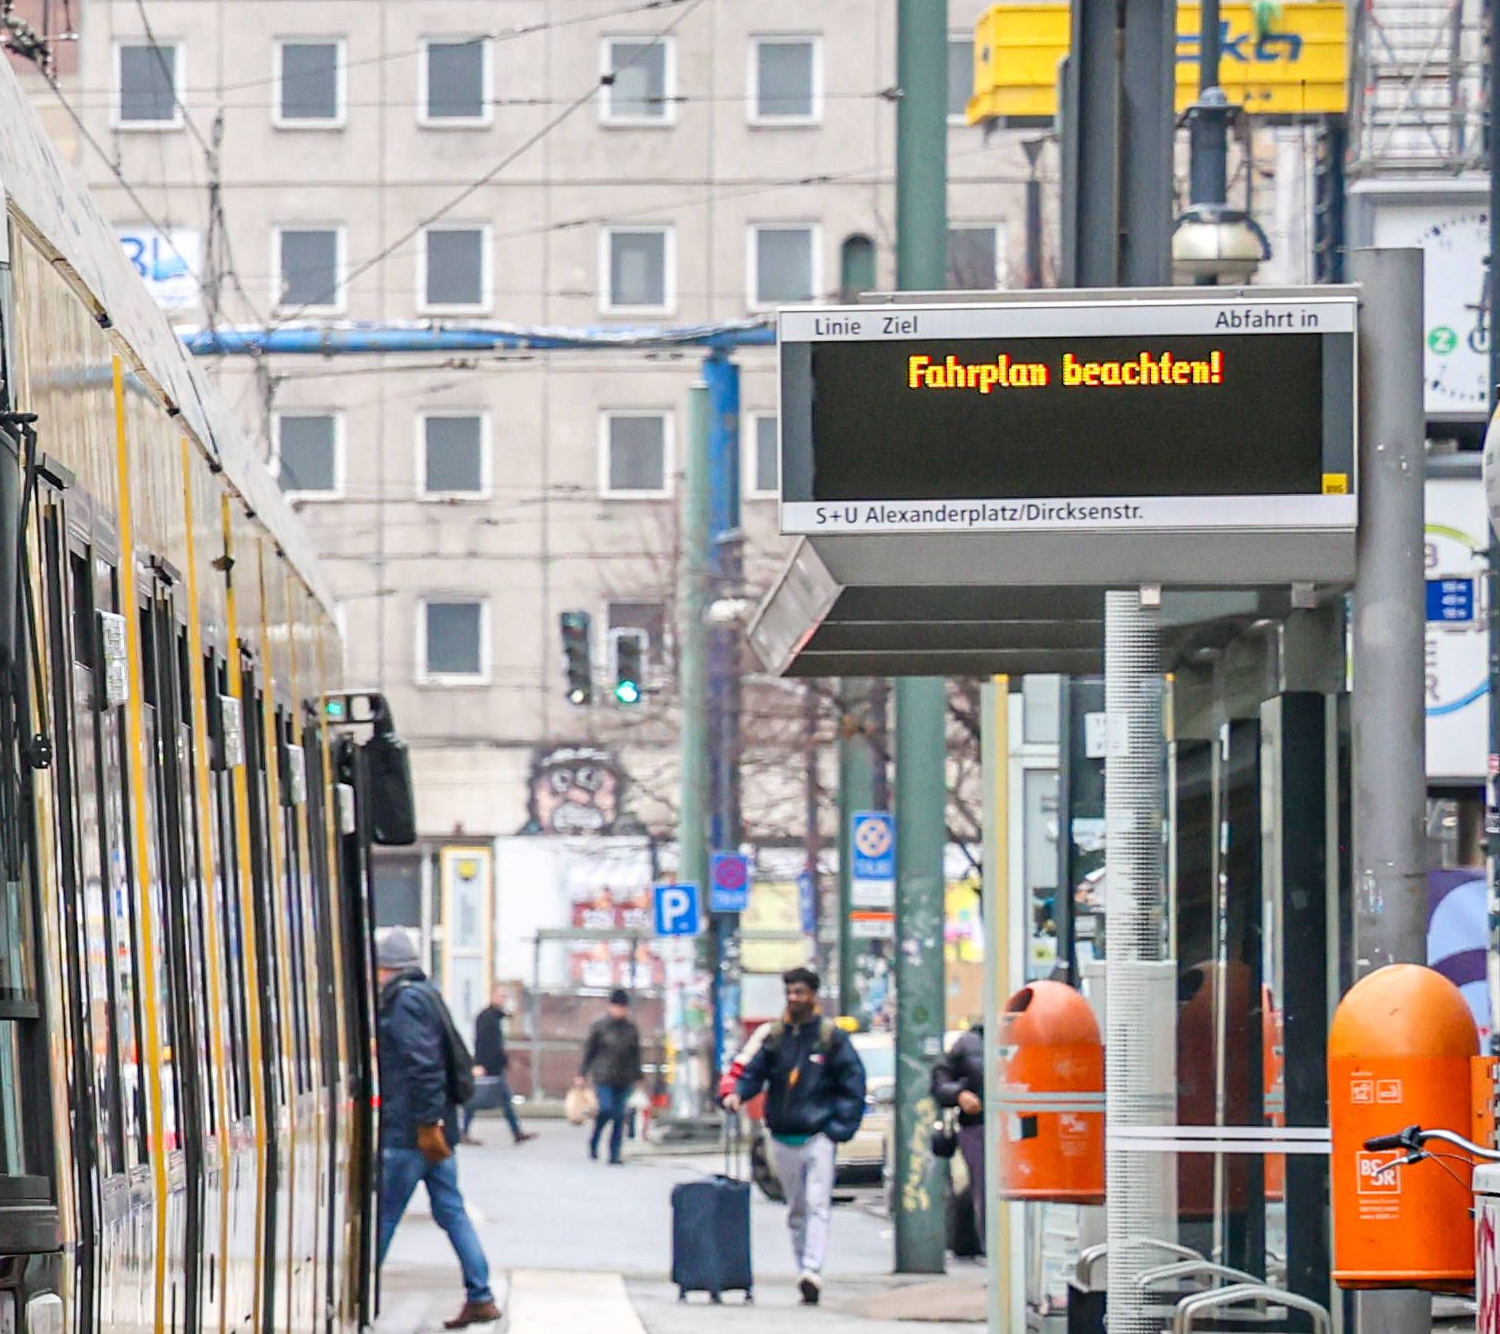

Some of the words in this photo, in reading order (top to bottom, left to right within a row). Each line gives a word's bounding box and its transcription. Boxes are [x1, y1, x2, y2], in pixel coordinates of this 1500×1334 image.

[815, 318, 861, 336] Linie
[883, 316, 918, 335] Ziel
[1215, 310, 1293, 329] Abfahrt
[1301, 310, 1319, 327] in
[907, 353, 1050, 394] Fahrplan
[1062, 350, 1224, 386] beachten!
[815, 506, 859, 525] S+U
[865, 501, 1144, 527] Alexanderplatz/Dircksenstr.
[661, 890, 690, 931] P
